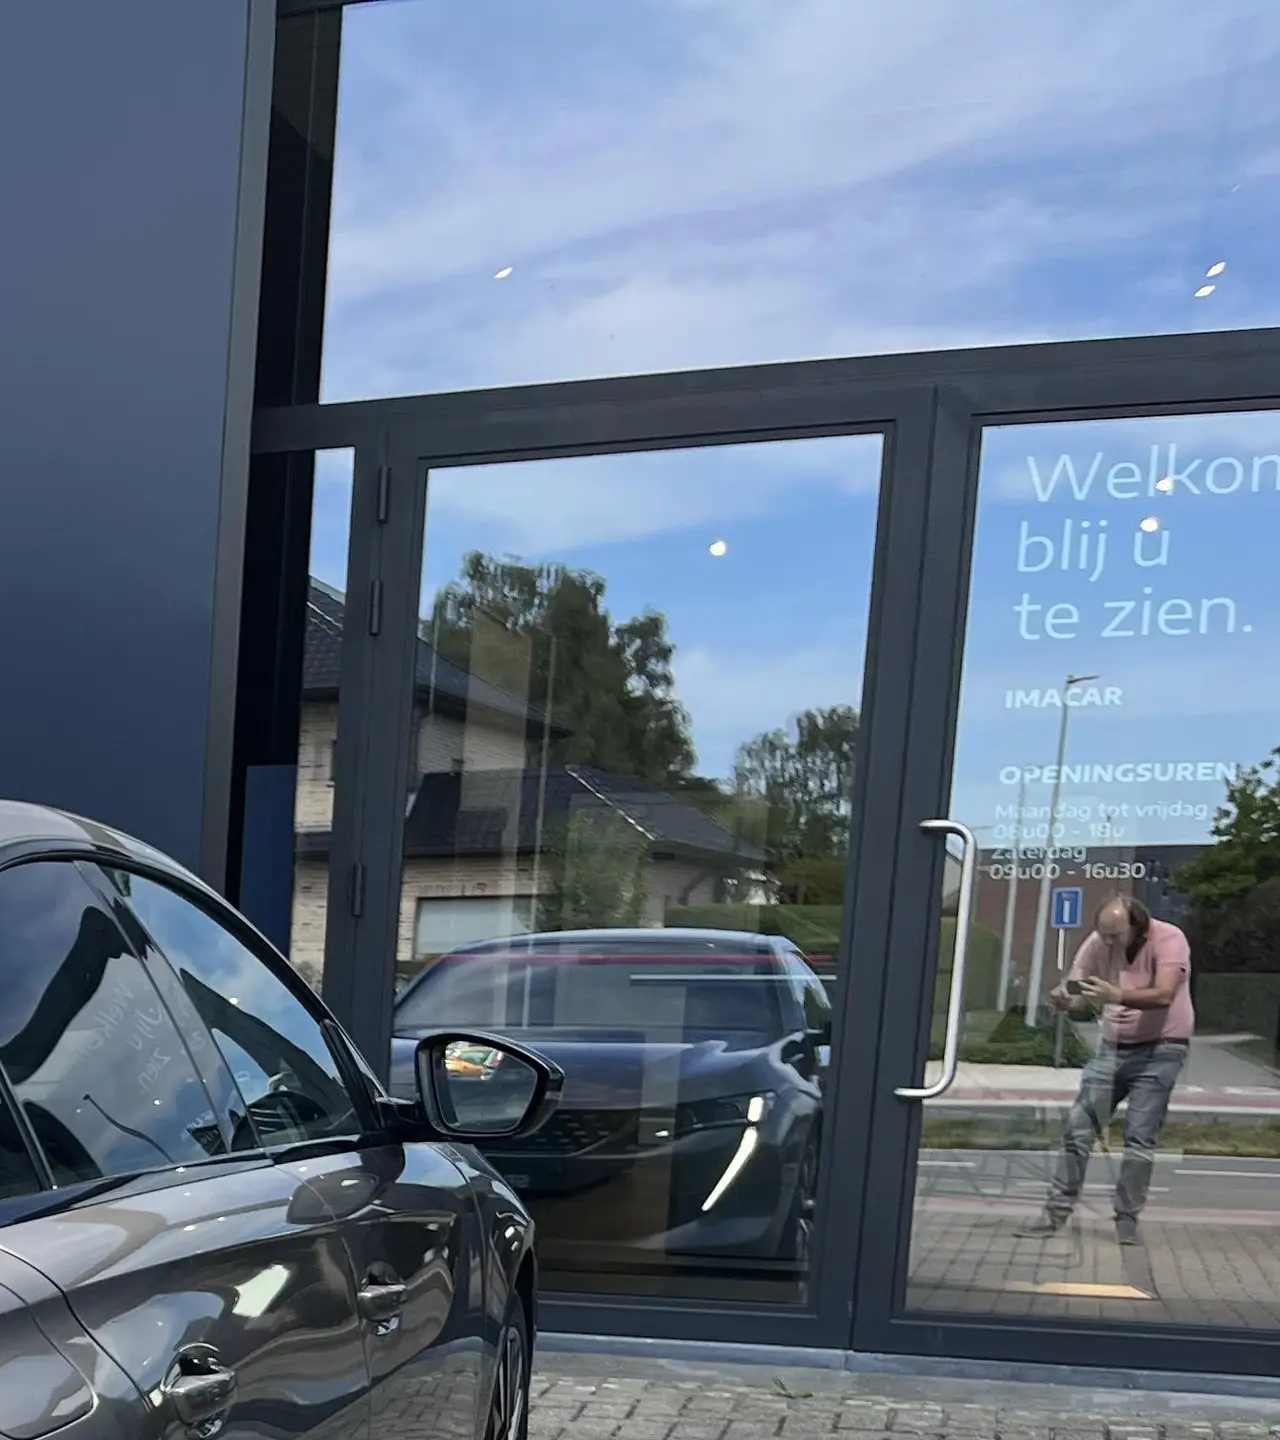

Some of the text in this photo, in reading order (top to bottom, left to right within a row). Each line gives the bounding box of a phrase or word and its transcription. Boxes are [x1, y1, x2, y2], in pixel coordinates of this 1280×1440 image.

[1017, 518, 1170, 582] blij u
[1013, 586, 1253, 641] te zien.
[1004, 686, 1123, 709] IMACAR
[998, 761, 1239, 785] OPENINGSUREN
[994, 800, 1209, 823] Maandag tot vrijdag
[990, 844, 1088, 863] Zaterdag
[1084, 862, 1146, 880] 16u30
